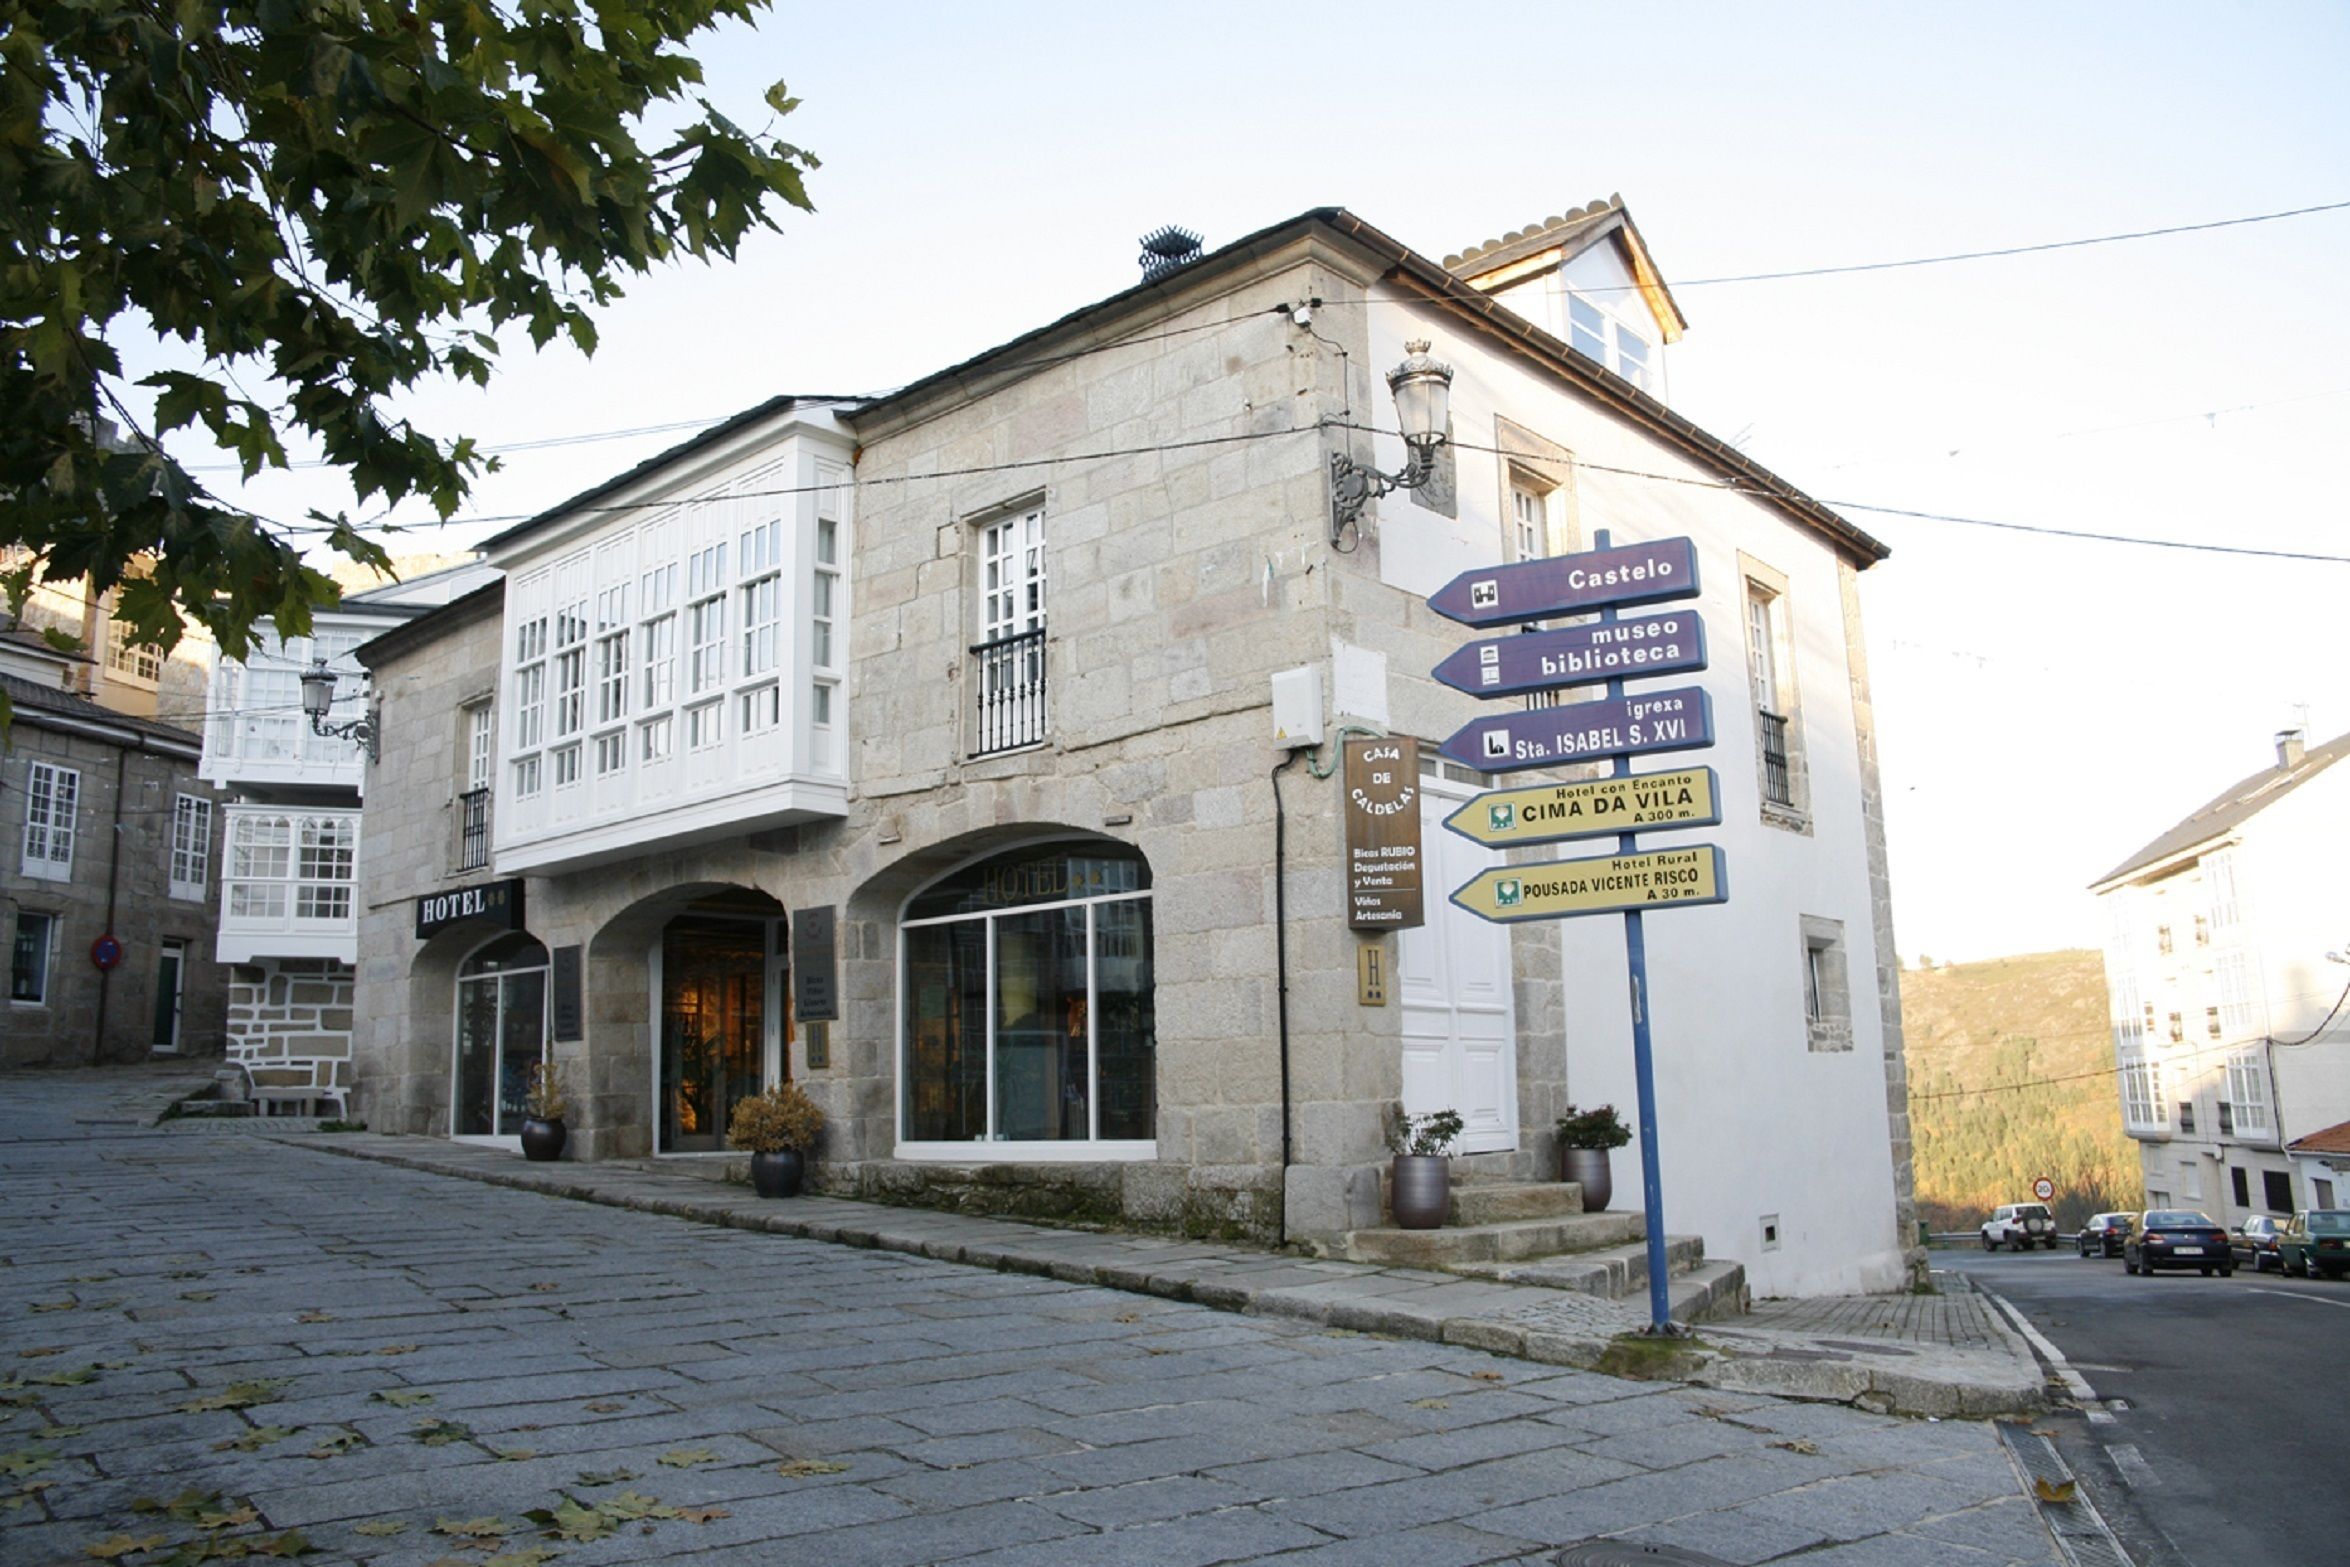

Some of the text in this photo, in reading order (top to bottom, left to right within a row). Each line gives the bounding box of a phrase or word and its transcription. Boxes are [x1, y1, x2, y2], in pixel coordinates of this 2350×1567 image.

[1568, 558, 1673, 590] Castelo
[1591, 619, 1678, 644] museo
[1541, 643, 1681, 675] biblioteca
[1626, 698, 1683, 720] igrexa
[1515, 718, 1686, 760] Sta. ISABEL S. XVI
[1363, 746, 1400, 762] CASA
[1372, 772, 1391, 784] DE
[1556, 775, 1692, 799] Hotel con Encanto
[1352, 785, 1415, 815] CALDELAS
[1522, 788, 1693, 823] CIMA DA VILA
[1634, 809, 1695, 823] A 300 m.
[1380, 846, 1415, 857] RUBIO
[1612, 851, 1698, 871] Hotel Rural
[984, 859, 1068, 904] HOTEL
[1354, 876, 1393, 888] y Venta
[1523, 867, 1699, 899] POUSADA VICENTE RISCO
[1647, 886, 1700, 900] A 30 m.
[422, 889, 486, 924] HOTEL
